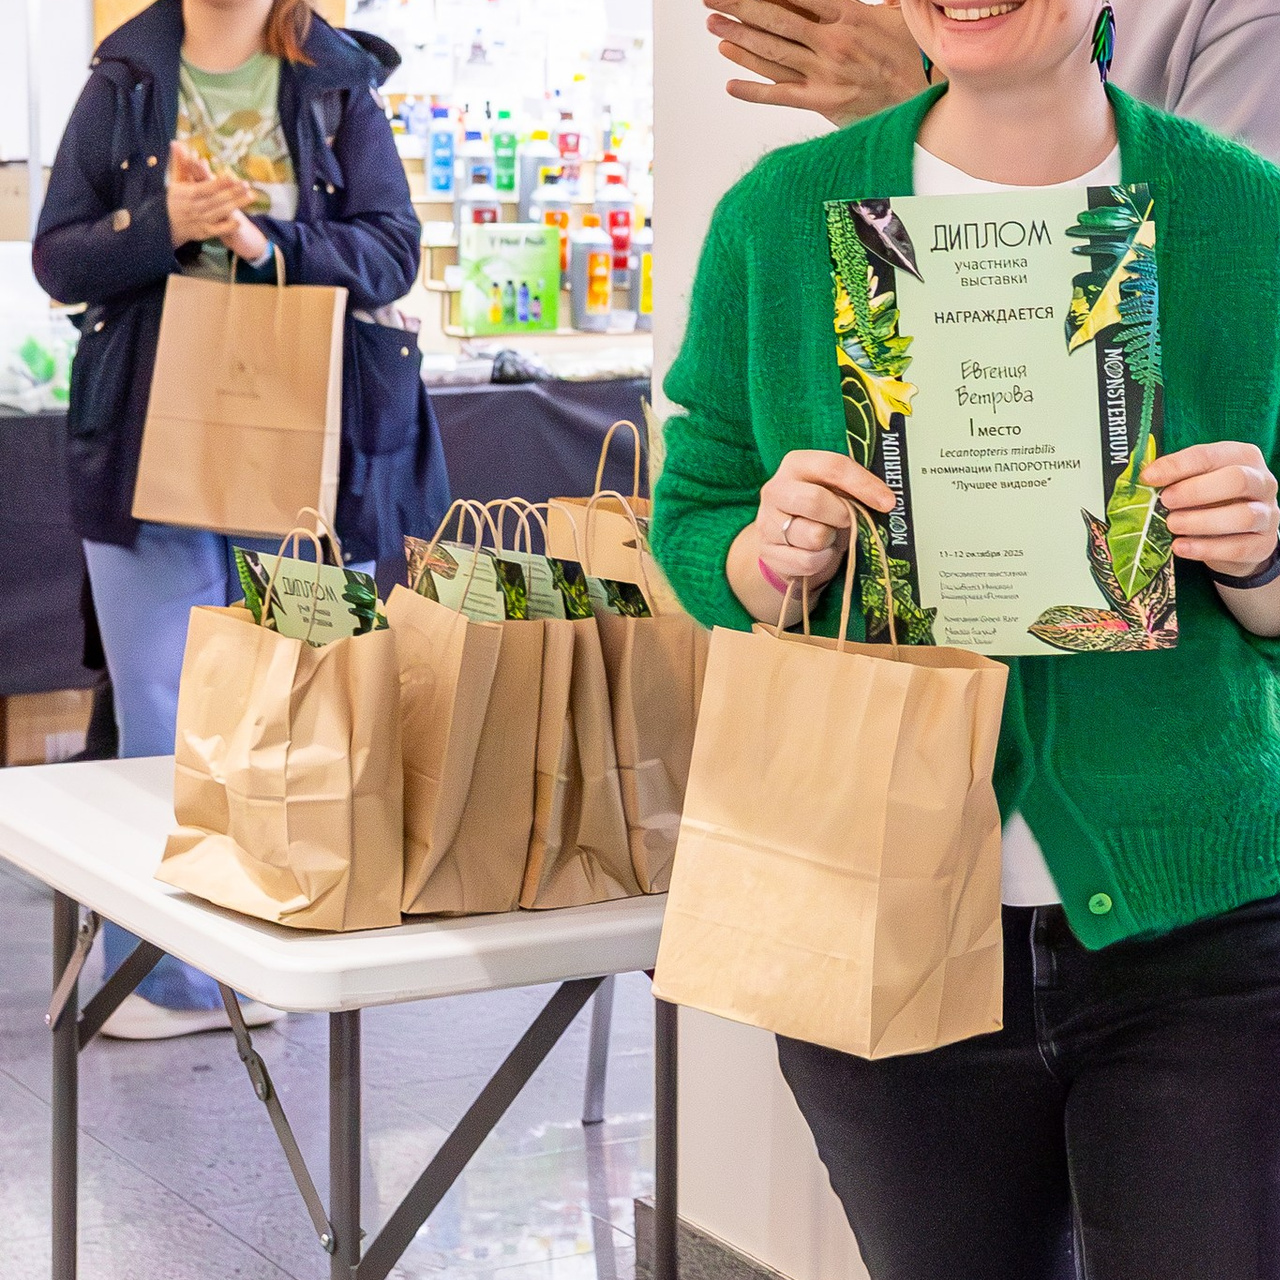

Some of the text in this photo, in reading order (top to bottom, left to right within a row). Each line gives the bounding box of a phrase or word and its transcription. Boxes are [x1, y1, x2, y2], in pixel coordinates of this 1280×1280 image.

[930, 220, 1053, 252] ДИПЛОМ
[954, 257, 1028, 274] участника
[961, 274, 1028, 287] выставки
[934, 306, 1054, 324] НАГРАЖДАЕТСЯ
[961, 359, 1027, 380] Евгения
[1104, 347, 1129, 465] MONSTERRIUM
[978, 424, 1022, 437] место
[1011, 444, 1056, 455] mirabilis
[921, 459, 1081, 475] в номинации ПАПОРОТНИКИ
[1003, 549, 1024, 557] 2025
